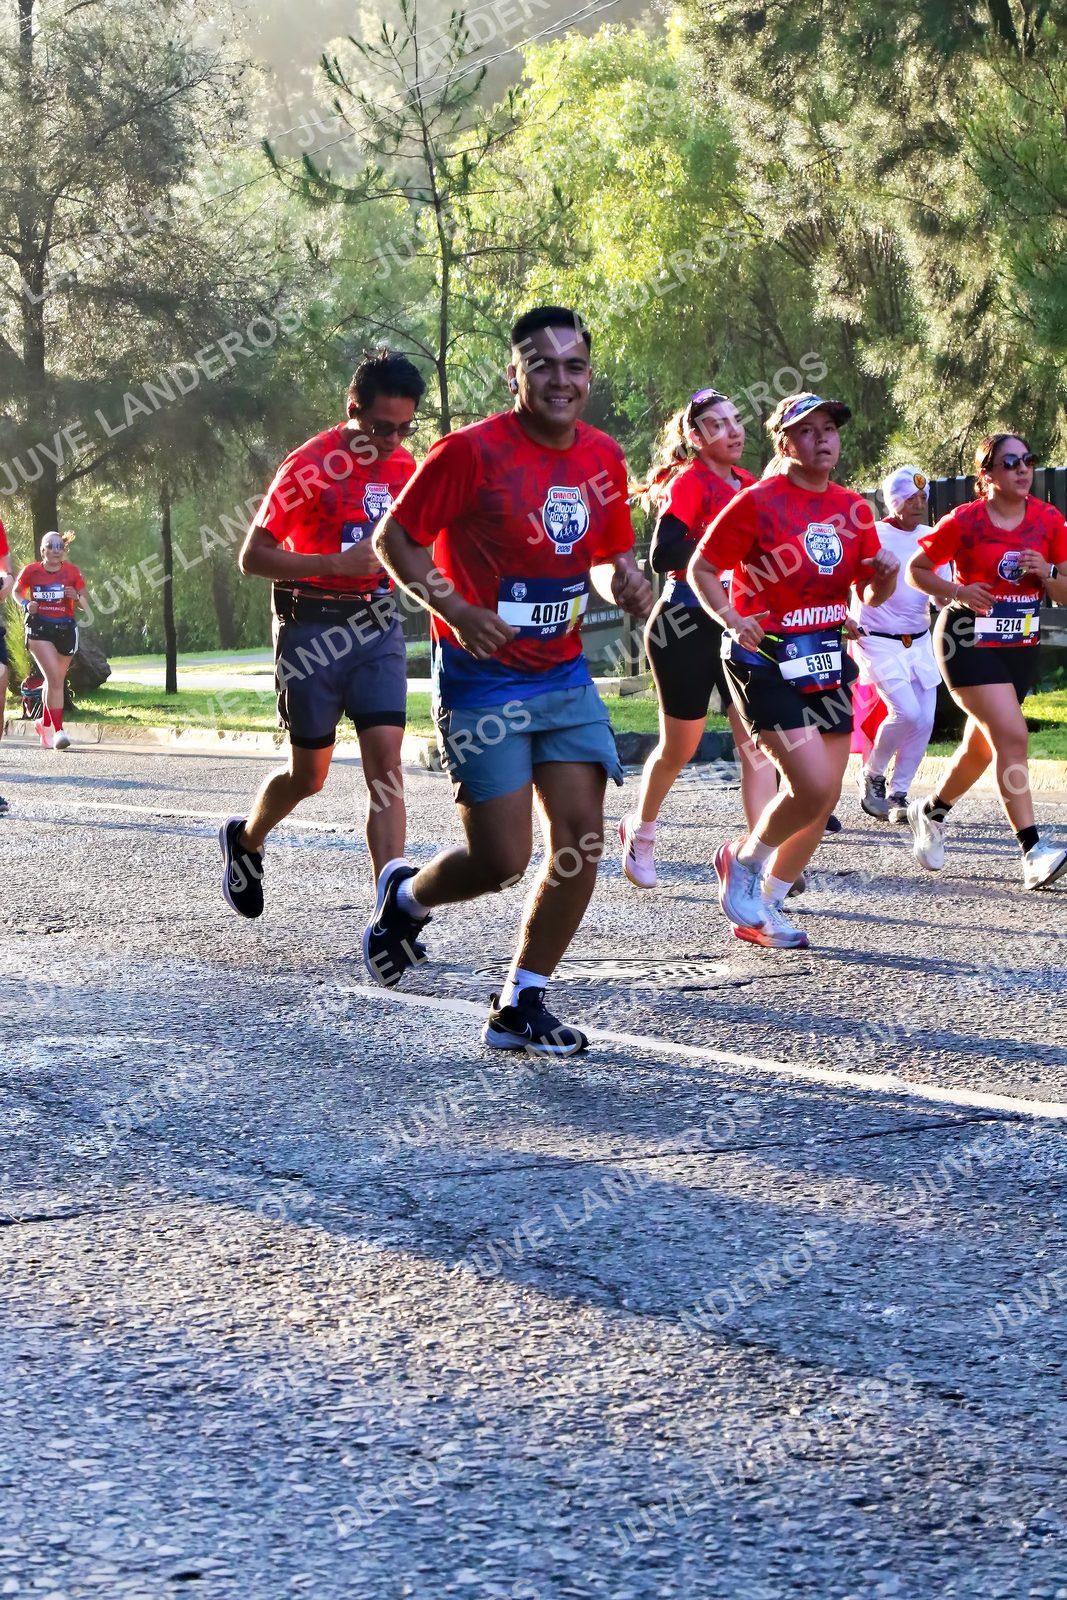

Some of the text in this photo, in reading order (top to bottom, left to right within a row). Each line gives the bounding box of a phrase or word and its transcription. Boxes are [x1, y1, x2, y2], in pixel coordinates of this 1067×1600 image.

[552, 491, 577, 500] BIMBO
[553, 502, 577, 513] Global
[549, 511, 569, 522] Race
[531, 602, 569, 624] 4019
[782, 604, 848, 627] SANTIAGO
[995, 619, 1022, 632] 5214
[805, 653, 833, 673] 5319
